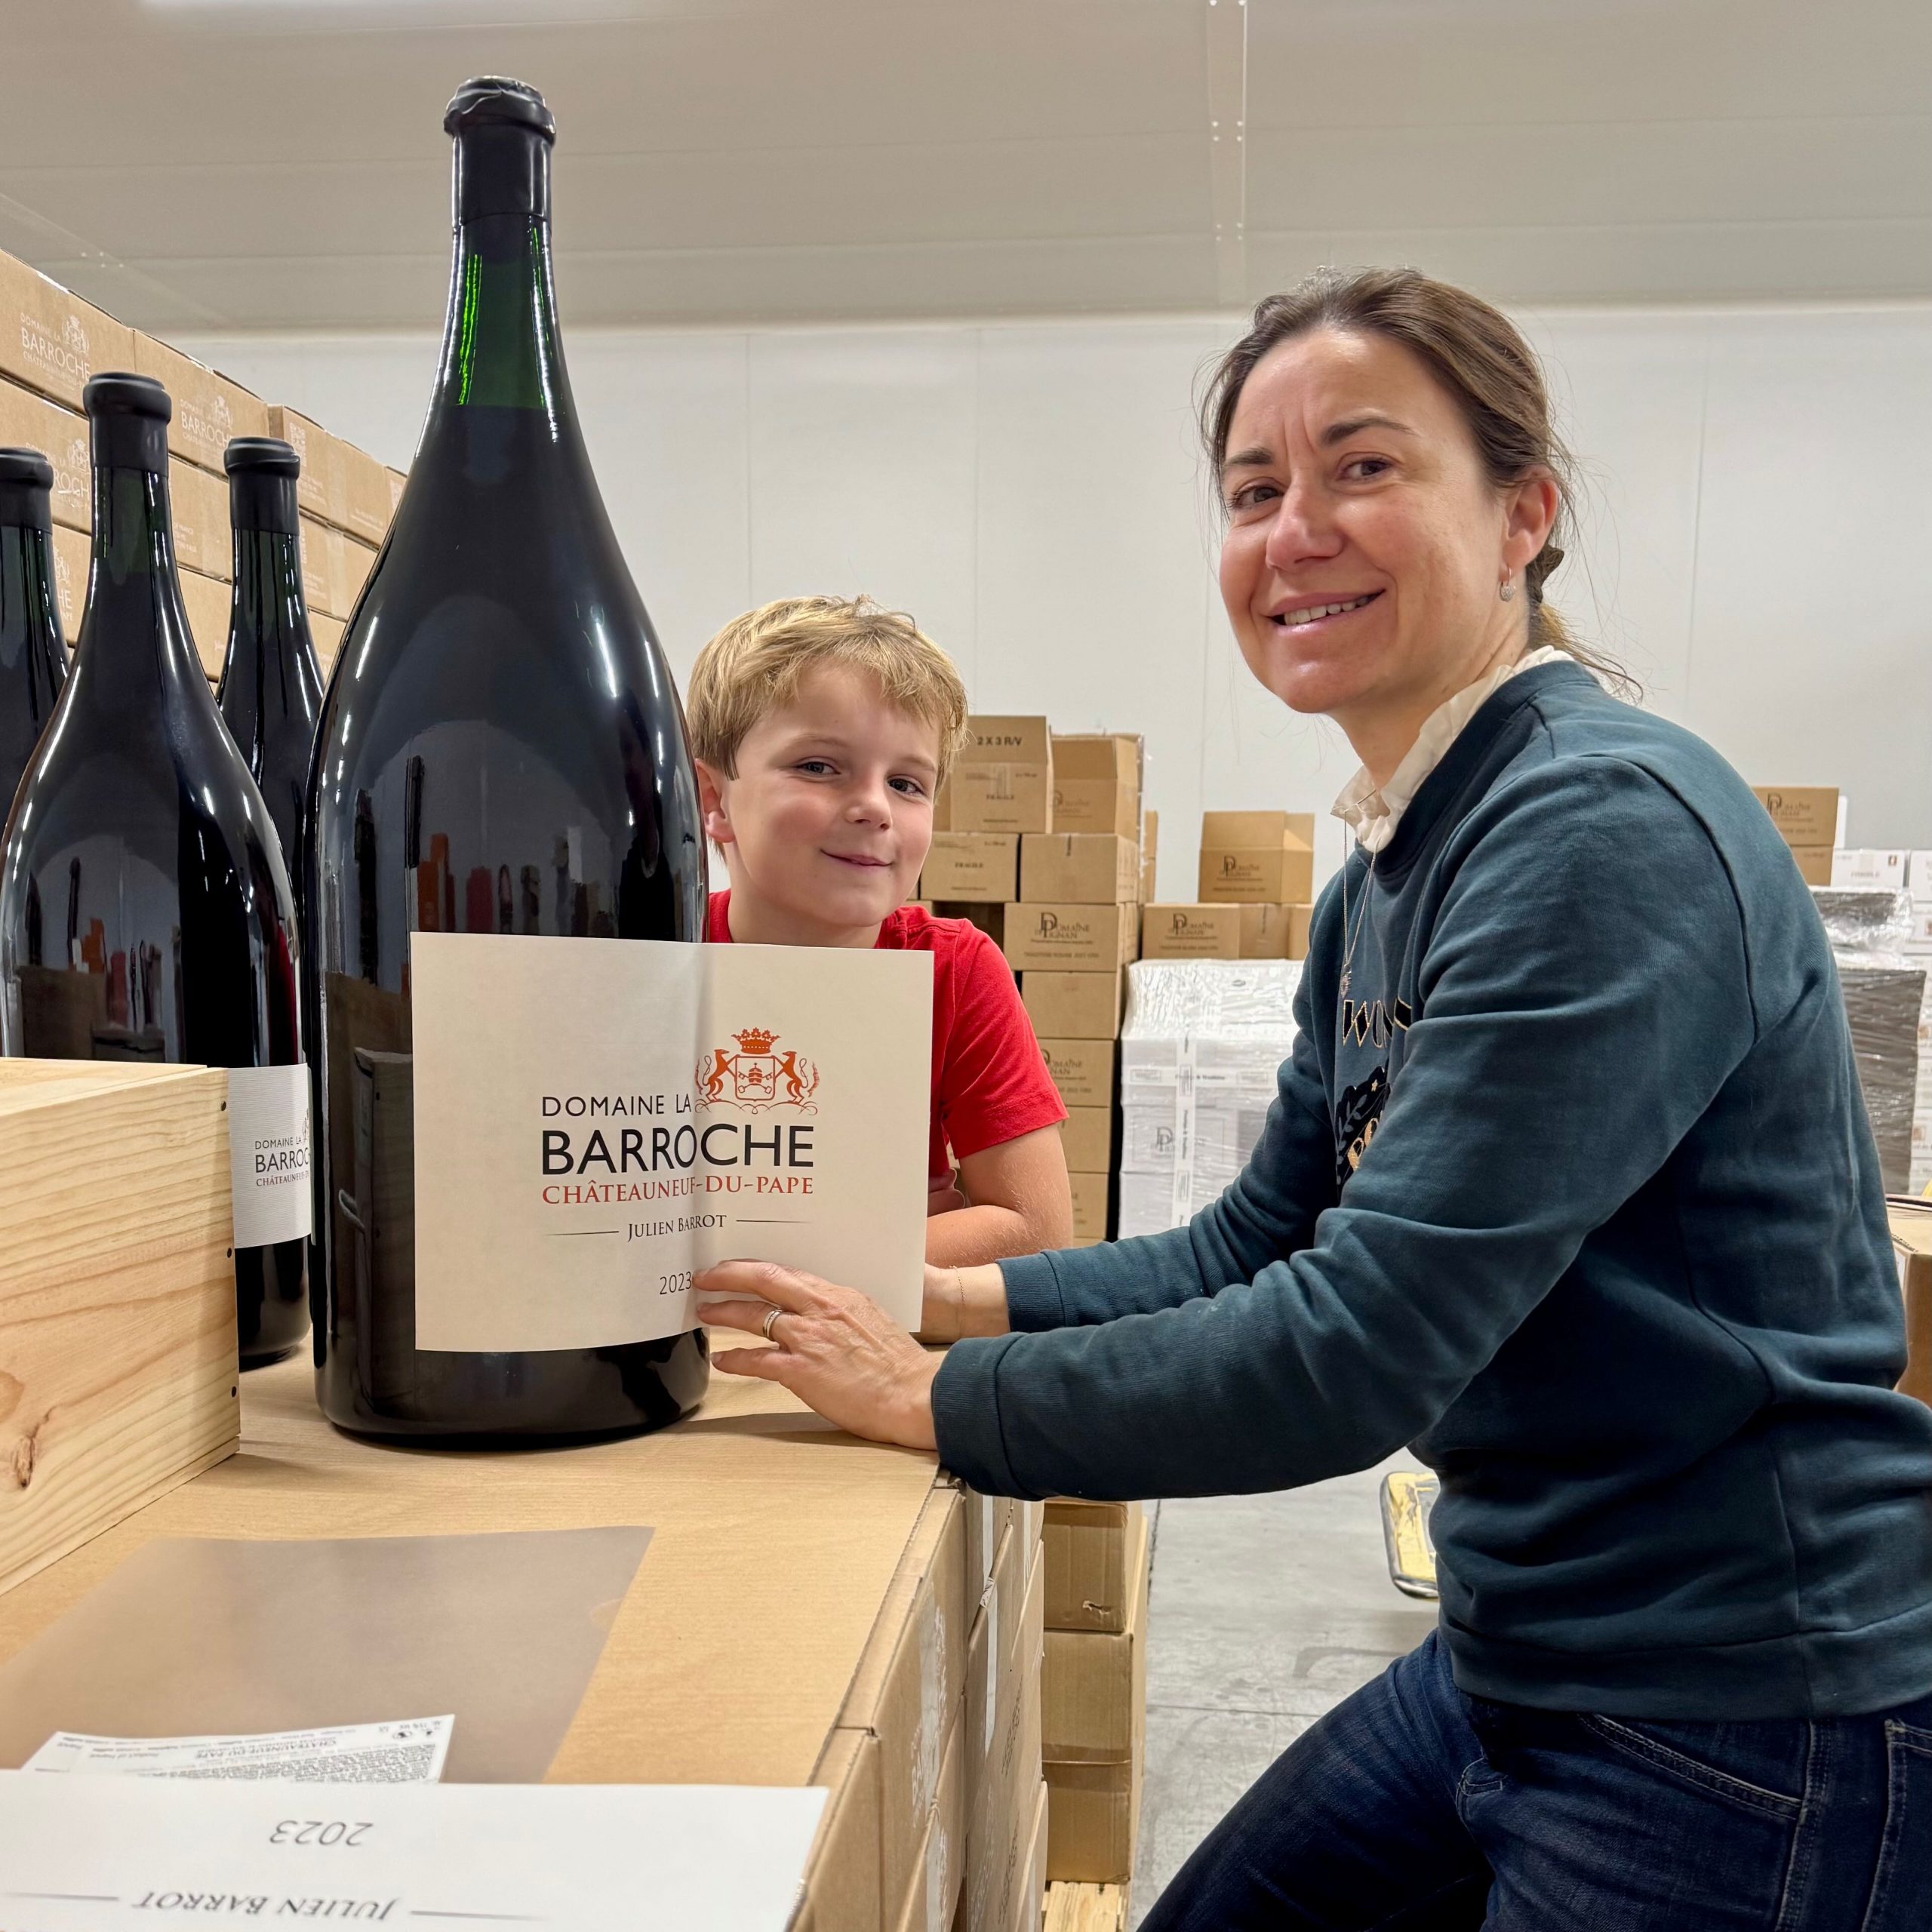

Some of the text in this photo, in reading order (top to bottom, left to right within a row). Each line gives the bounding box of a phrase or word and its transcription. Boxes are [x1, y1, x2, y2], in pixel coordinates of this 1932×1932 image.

[21, 327, 91, 383] BARROCHE
[181, 411, 233, 448] BARROCH
[542, 1094, 691, 1117] DOMAINE LA
[255, 1136, 302, 1150] DOMAINE LA
[542, 1123, 814, 1176] BARROCHE
[542, 1175, 814, 1204] CHÂTEAUNEUF-DU-PAPE
[628, 1214, 728, 1243] JULIEN BARROT
[659, 1271, 692, 1295] 2023
[269, 1820, 374, 1847] 2023
[131, 1890, 402, 1921] JULIEN BARROT
